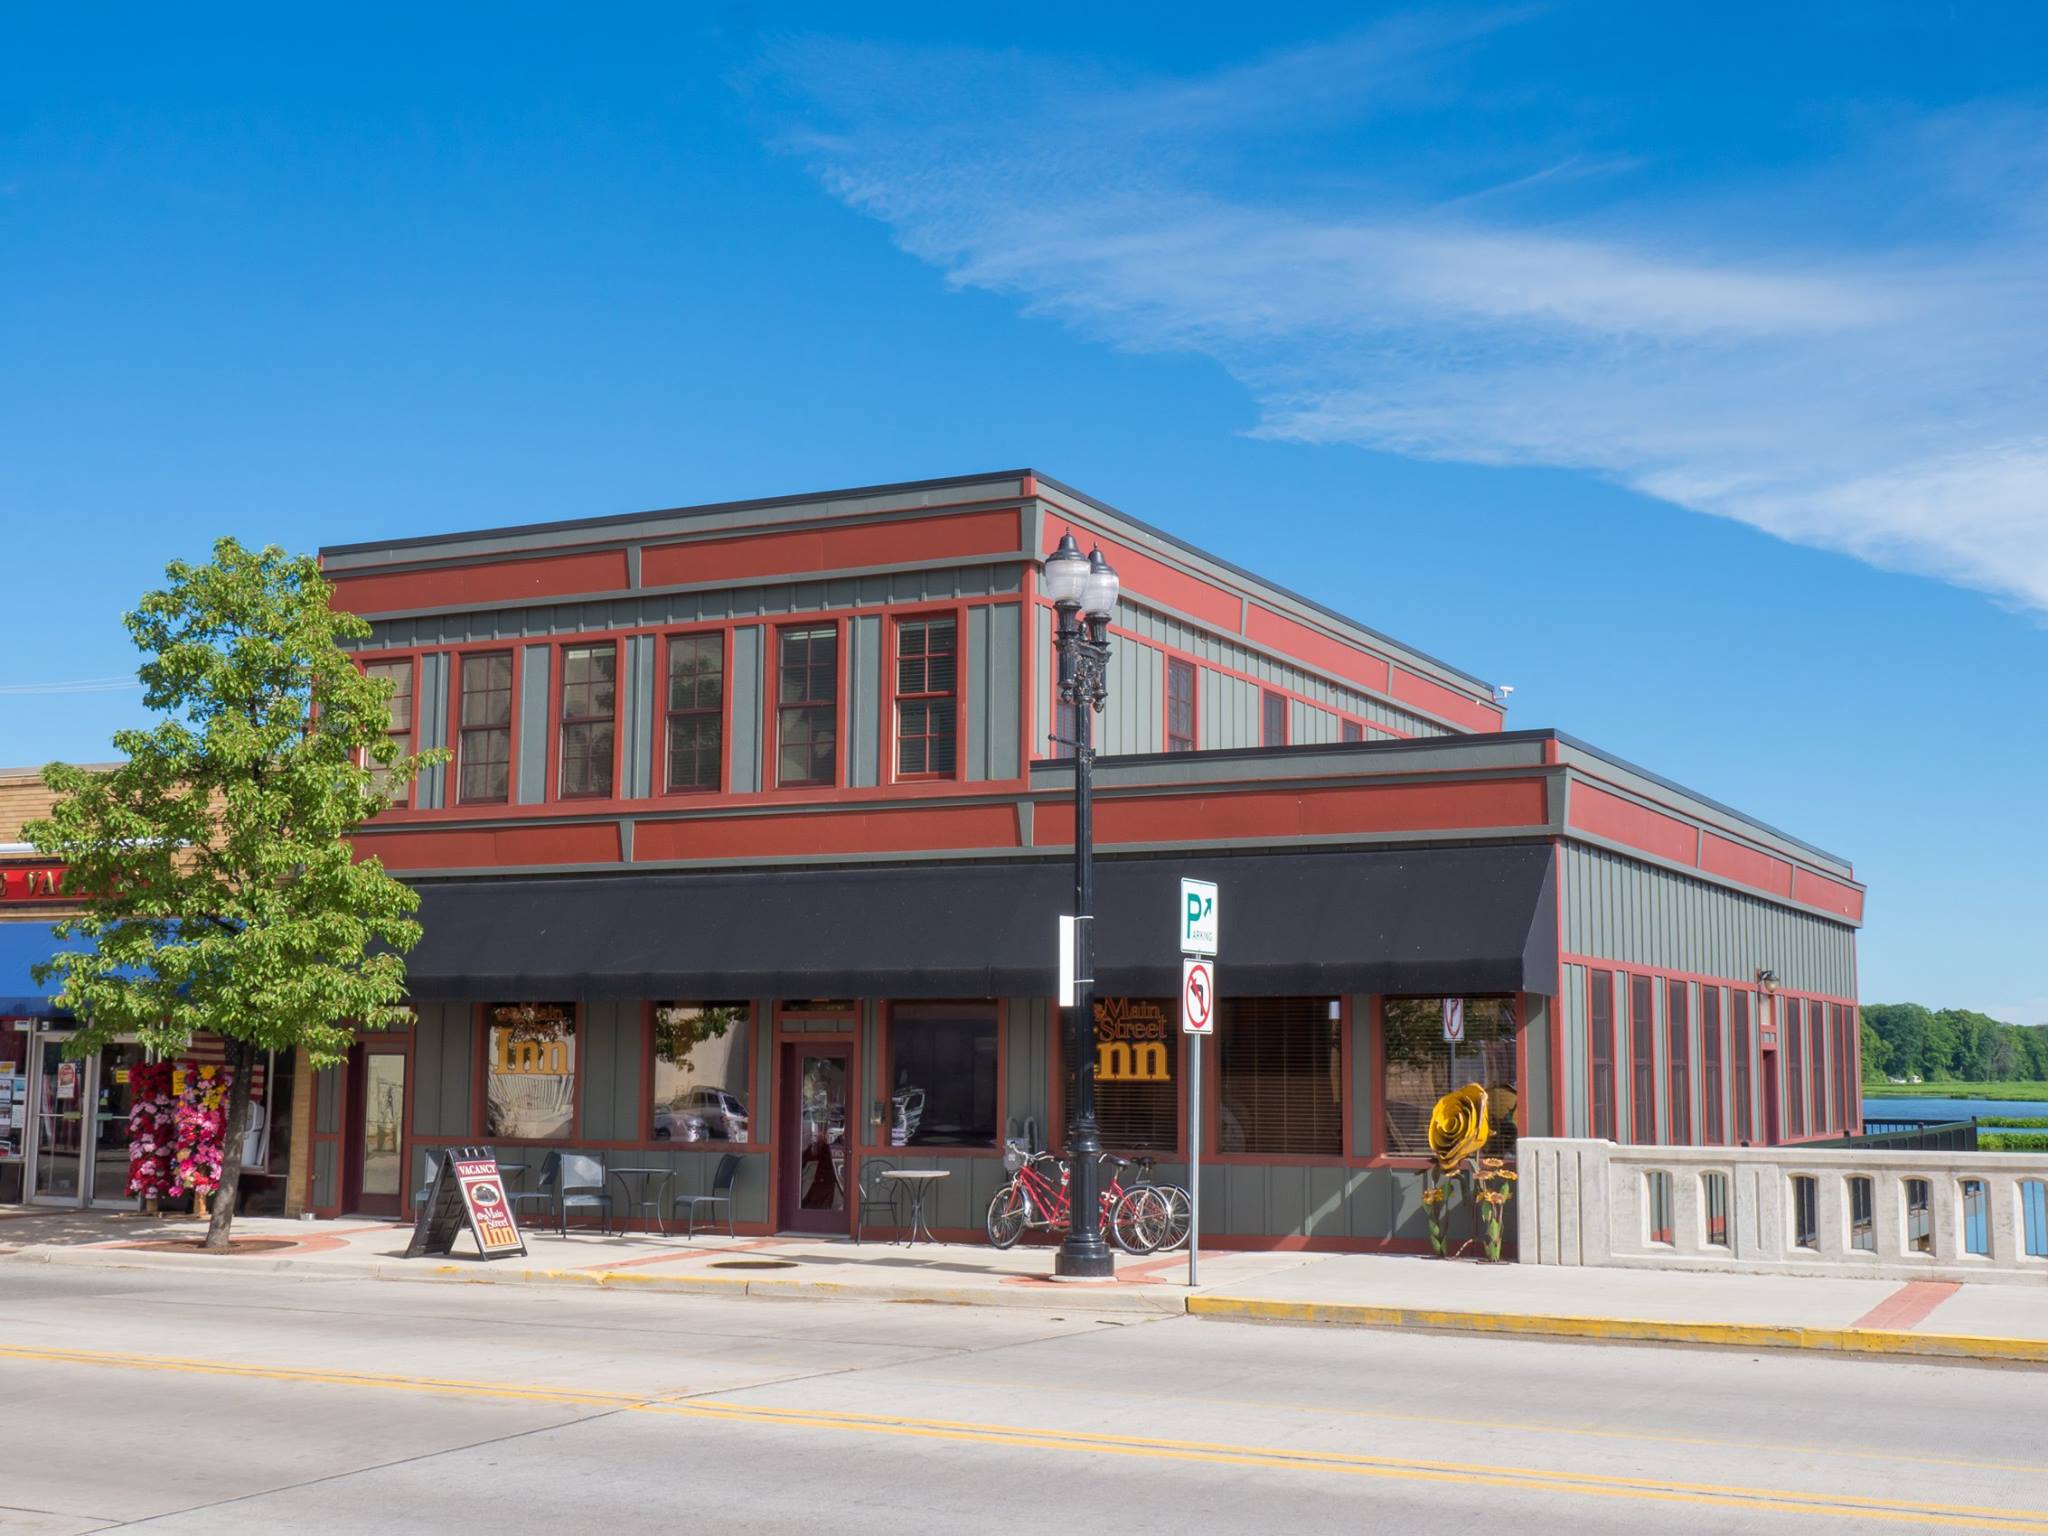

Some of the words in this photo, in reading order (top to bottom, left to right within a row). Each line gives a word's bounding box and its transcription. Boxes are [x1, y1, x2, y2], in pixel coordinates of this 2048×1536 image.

[1103, 995, 1161, 1020] Main
[1100, 1015, 1168, 1041] Street
[494, 1028, 569, 1074] Inn
[1094, 1041, 1170, 1081] nn
[458, 1164, 497, 1176] VACANCY
[479, 1221, 517, 1248] Inn
